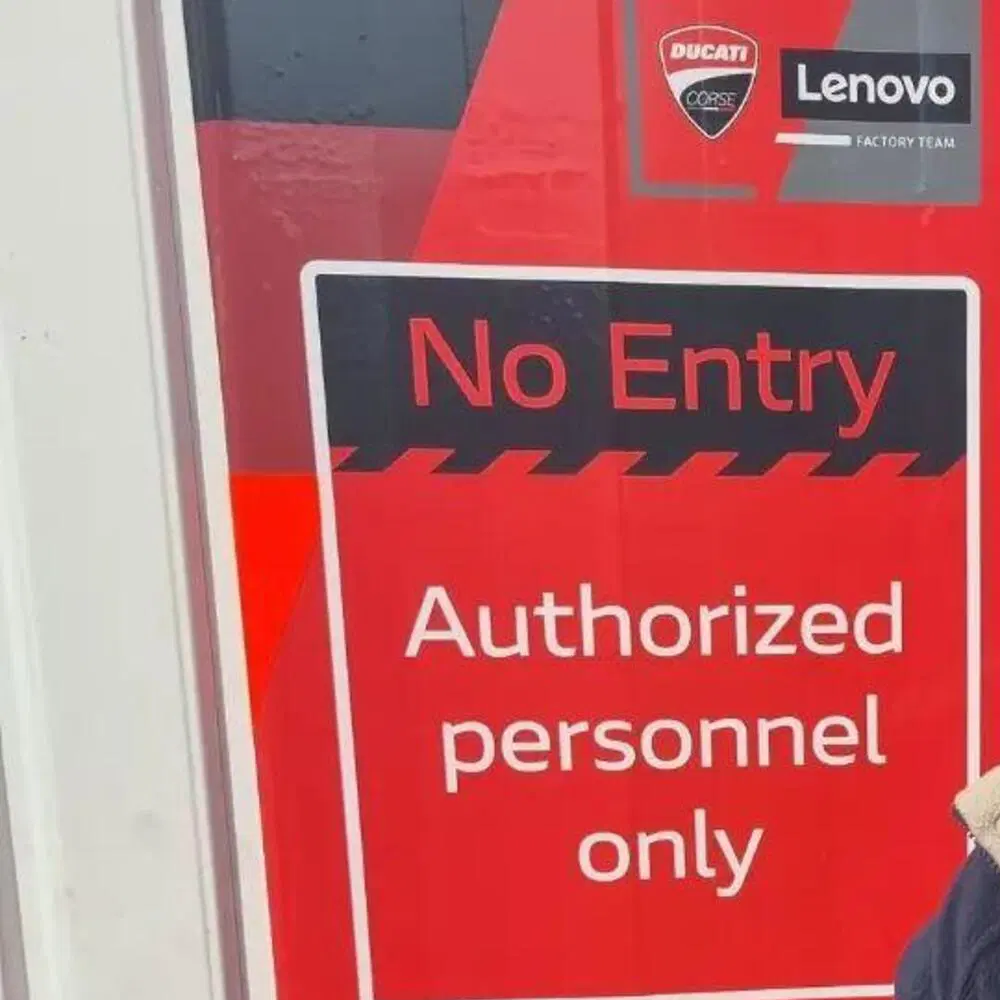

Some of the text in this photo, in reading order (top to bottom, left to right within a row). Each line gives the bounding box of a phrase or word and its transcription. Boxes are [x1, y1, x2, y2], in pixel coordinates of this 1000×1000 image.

[669, 42, 748, 62] DUCATI
[686, 90, 738, 107] CORSE
[797, 63, 956, 106] Lenovo
[856, 136, 956, 149] FACTORY TEAM
[409, 315, 897, 440] No Entry
[405, 581, 903, 658] Authorized
[442, 694, 886, 793] personnel
[578, 808, 764, 897] only
